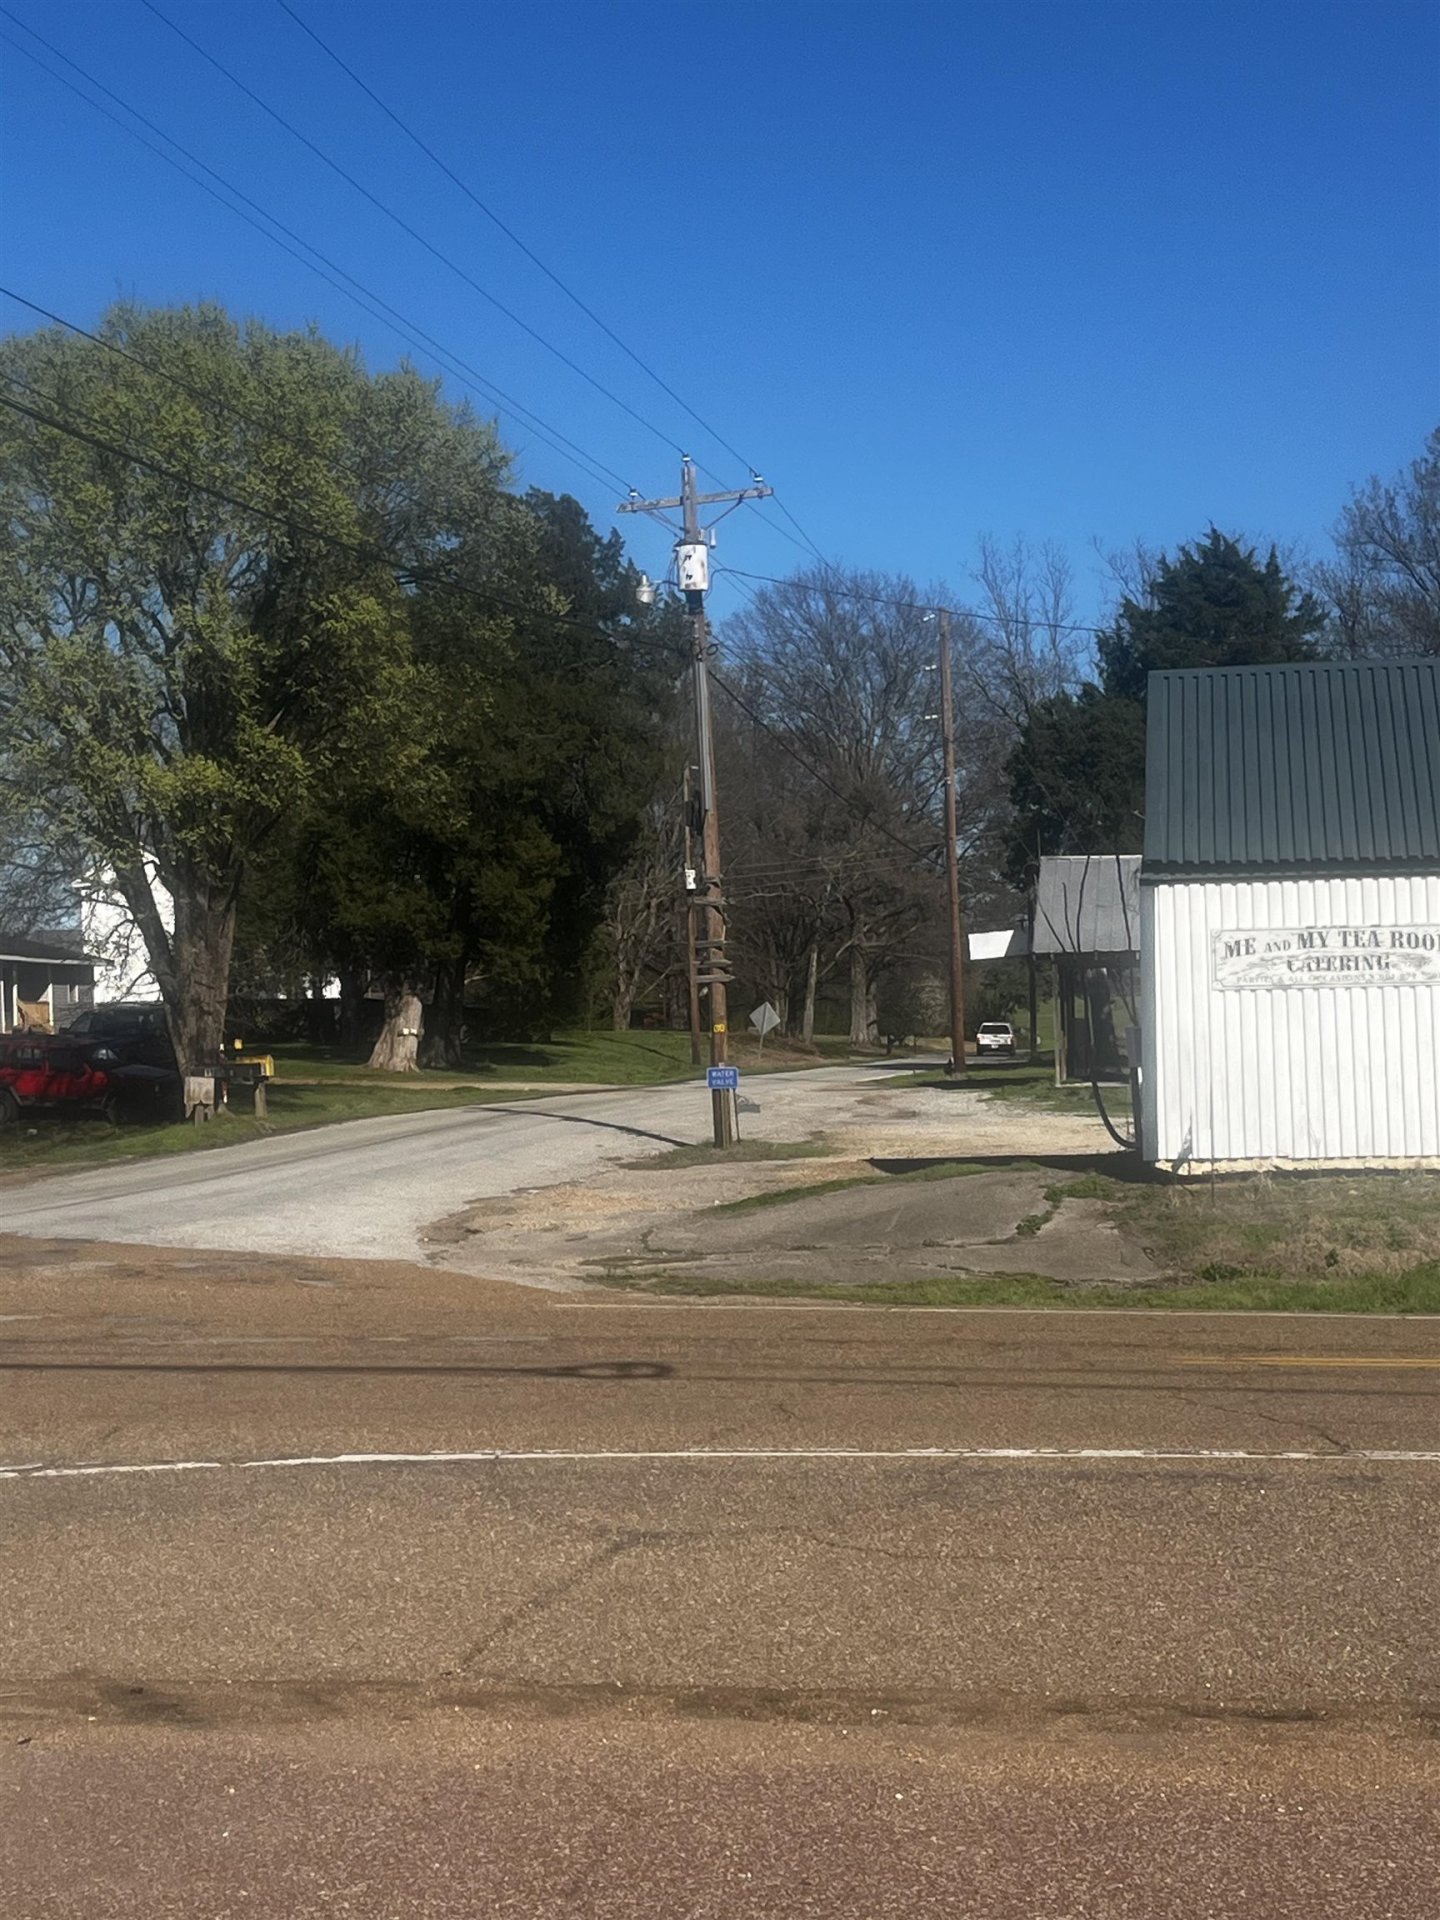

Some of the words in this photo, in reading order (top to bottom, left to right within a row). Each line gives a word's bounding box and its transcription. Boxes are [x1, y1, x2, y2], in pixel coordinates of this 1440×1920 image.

[1224, 937, 1256, 959] ME
[1264, 940, 1291, 953] AND
[1297, 931, 1330, 949] MY
[1338, 930, 1381, 948] TEA
[1287, 953, 1390, 973] CATERING
[711, 1078, 734, 1086] VALVE
